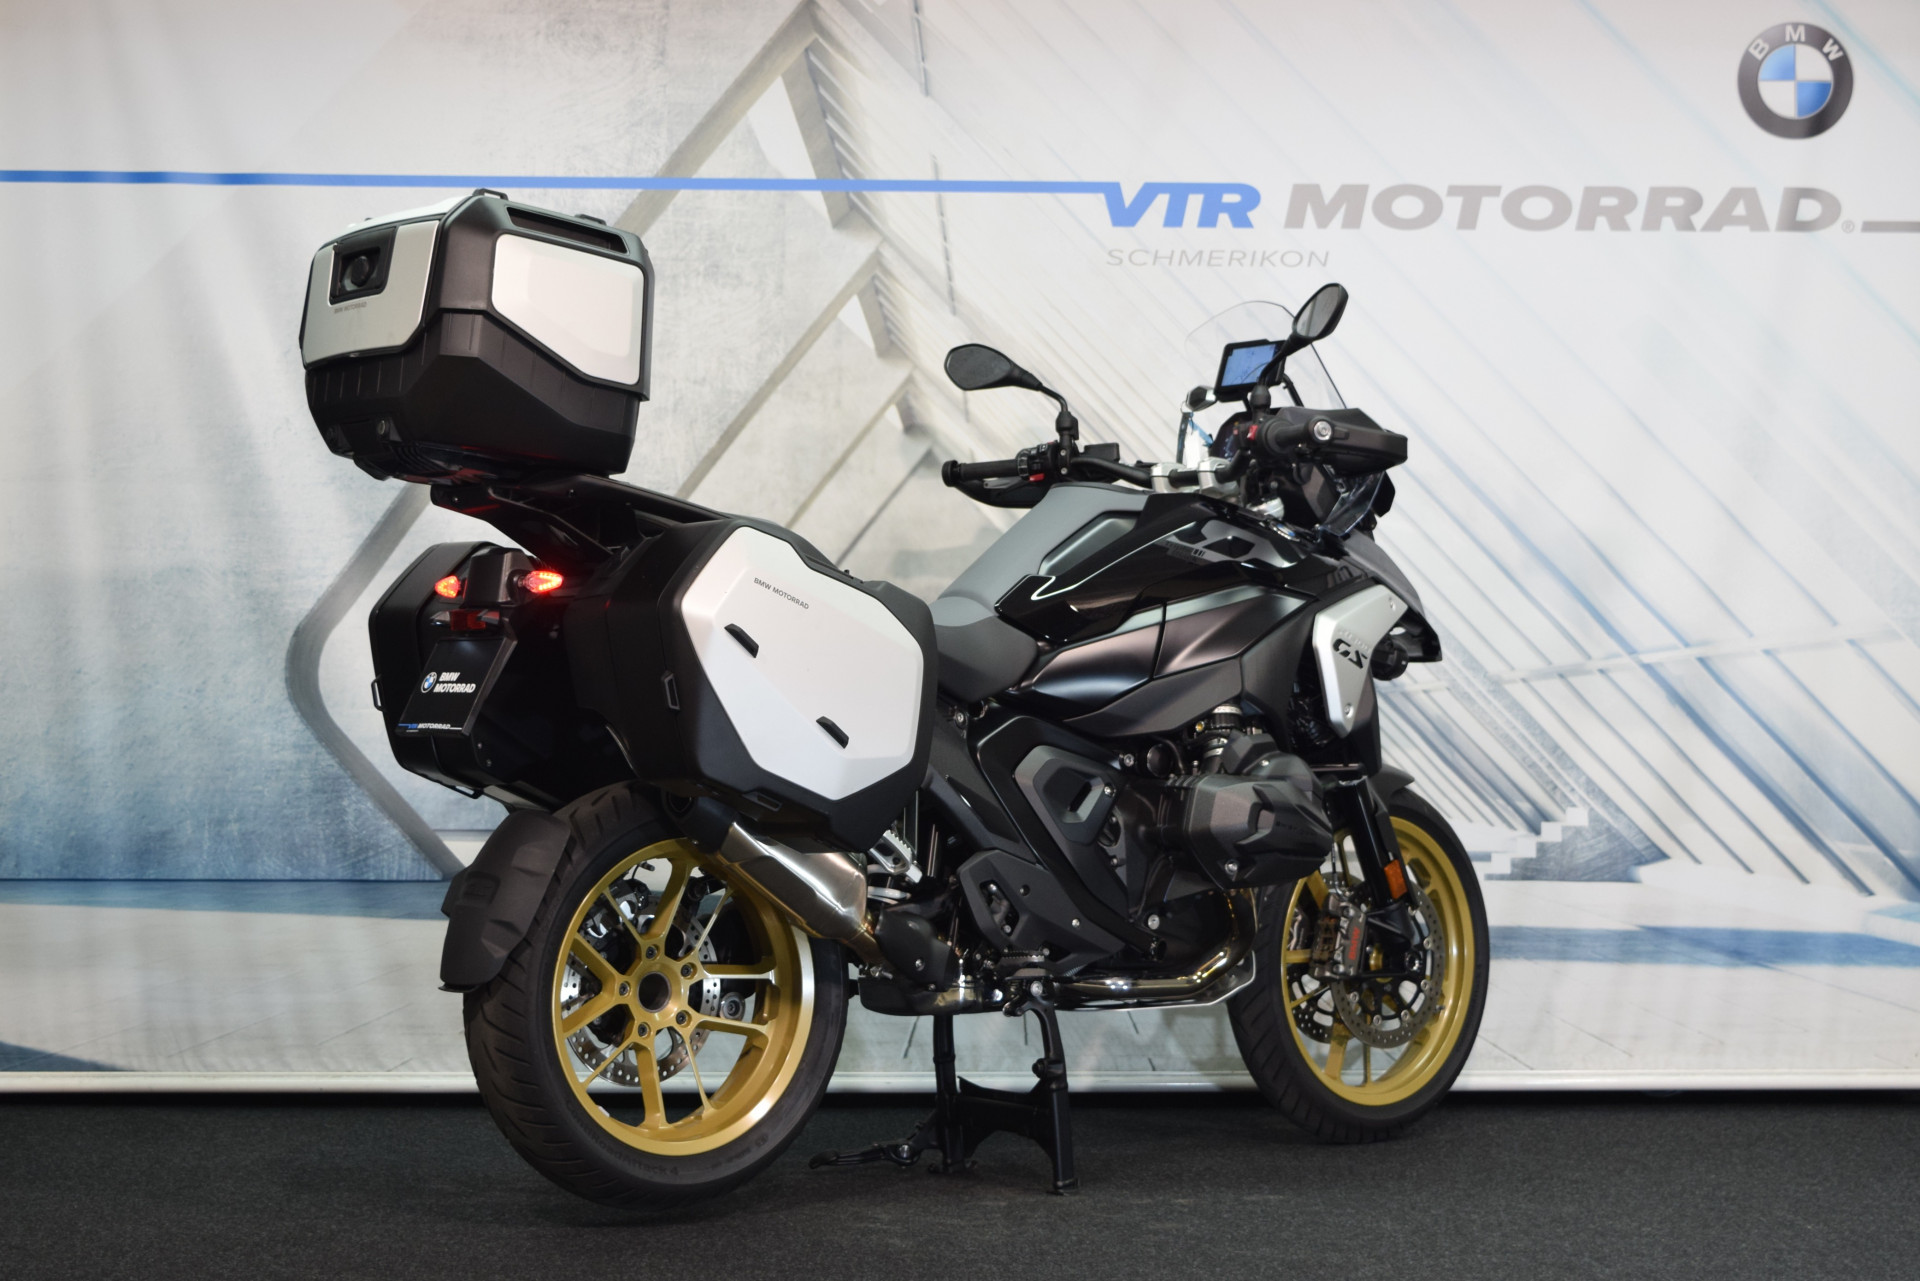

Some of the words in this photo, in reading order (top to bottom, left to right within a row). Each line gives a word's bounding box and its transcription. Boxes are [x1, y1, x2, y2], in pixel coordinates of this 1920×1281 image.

[1747, 23, 1844, 61] BMW
[1103, 181, 1262, 229] VTR
[1105, 248, 1330, 268] SCHMERIKON
[753, 577, 772, 590] BMW
[772, 586, 810, 610] MOTORRAD
[433, 683, 477, 693] MOTORRAD
[438, 671, 461, 682] BMW
